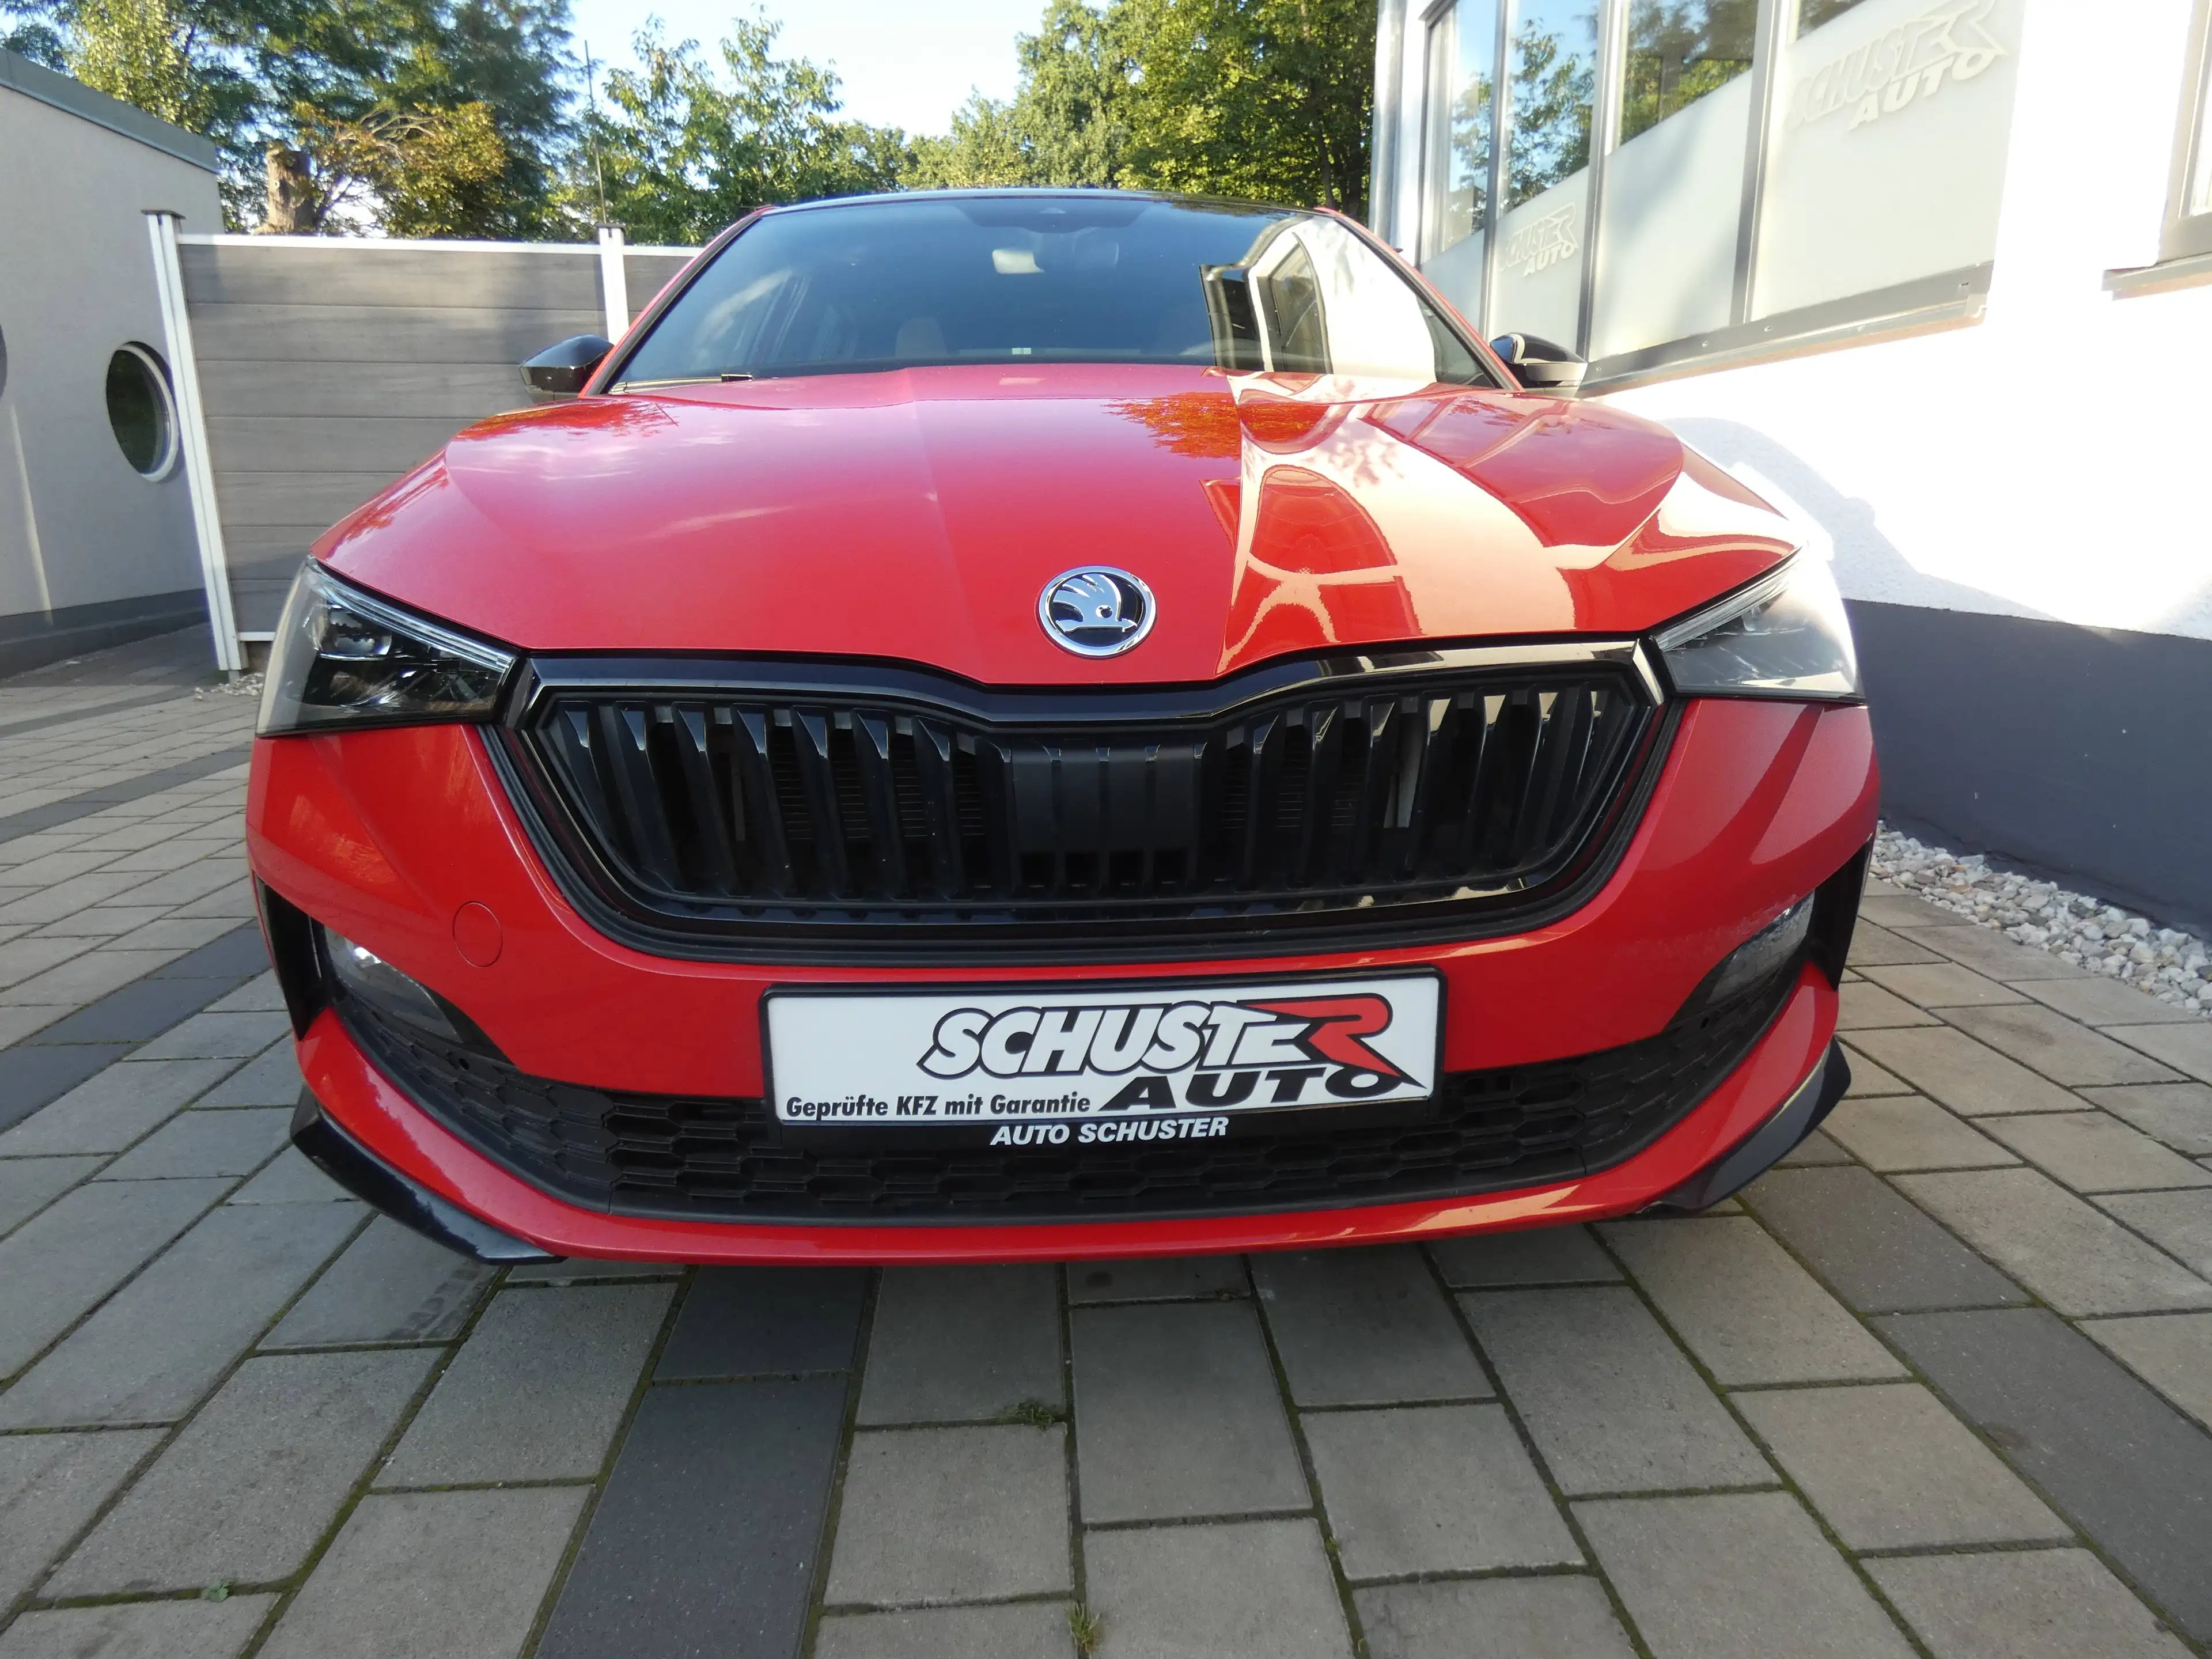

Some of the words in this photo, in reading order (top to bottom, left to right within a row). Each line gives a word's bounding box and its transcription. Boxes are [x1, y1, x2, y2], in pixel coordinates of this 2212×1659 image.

[1847, 50, 1995, 132] AUTO
[1522, 241, 1576, 278] AUTO
[915, 993, 1427, 1088] SCHUSTER
[786, 1094, 889, 1122] Geprüfte
[895, 1096, 940, 1116] KFZ
[944, 1093, 983, 1116] mit
[990, 1091, 1091, 1115] Garantie
[1098, 1066, 1403, 1111] AUTO
[989, 1123, 1070, 1146] AUTO
[1077, 1116, 1230, 1144] SCHUSTER
